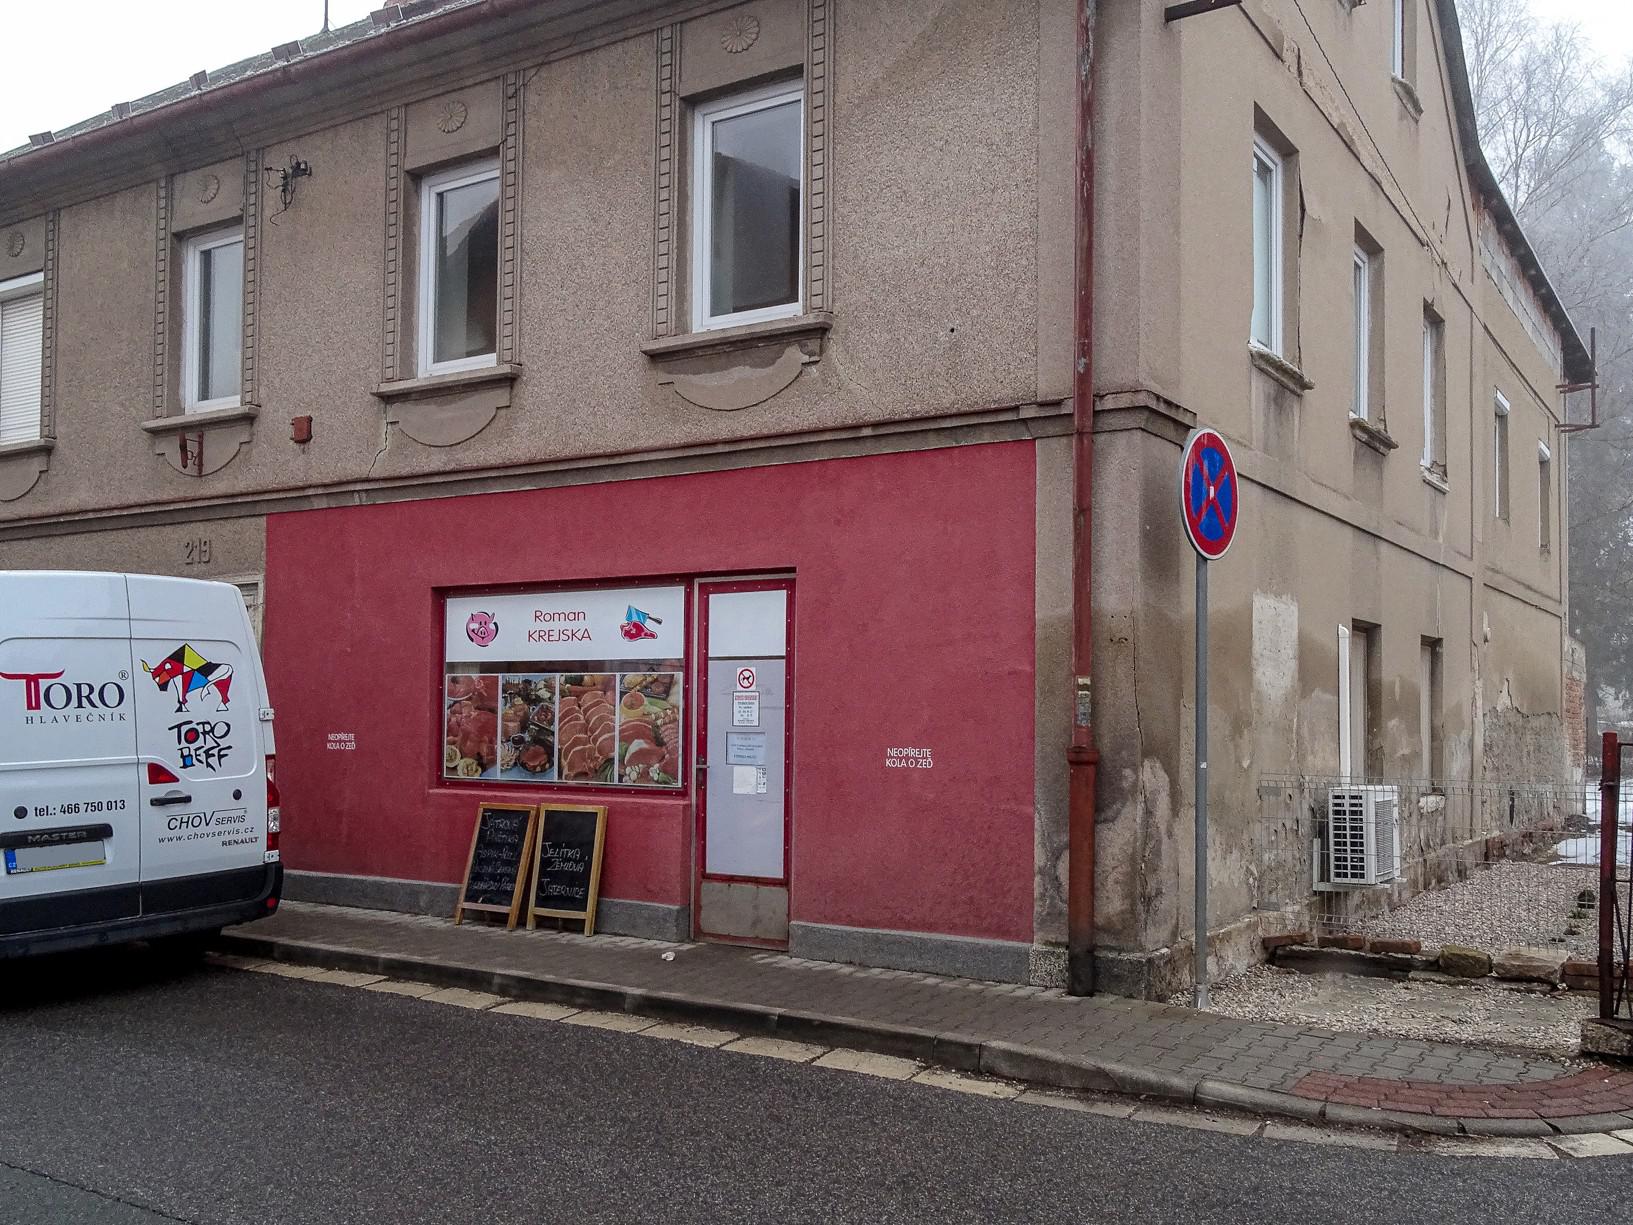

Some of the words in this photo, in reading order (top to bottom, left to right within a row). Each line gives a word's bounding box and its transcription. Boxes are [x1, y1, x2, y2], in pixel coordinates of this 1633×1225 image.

[534, 610, 586, 622] Roman
[528, 628, 592, 642] KREJSKA
[0, 669, 125, 711] TORO
[25, 712, 127, 725] HLAVEČNÍK
[168, 720, 231, 746] TORO
[177, 745, 233, 772] BEEF
[885, 758, 907, 768] KOLA
[908, 758, 916, 768] O
[34, 805, 57, 817] tel.:
[60, 803, 81, 815] 466
[84, 800, 104, 813] 750
[106, 799, 126, 811] 013
[167, 811, 216, 831] CHOV
[215, 814, 246, 826] SERVIS
[27, 831, 88, 843] MASTER
[158, 826, 255, 844] www.chovservis.cz
[221, 836, 259, 847] RENAULT
